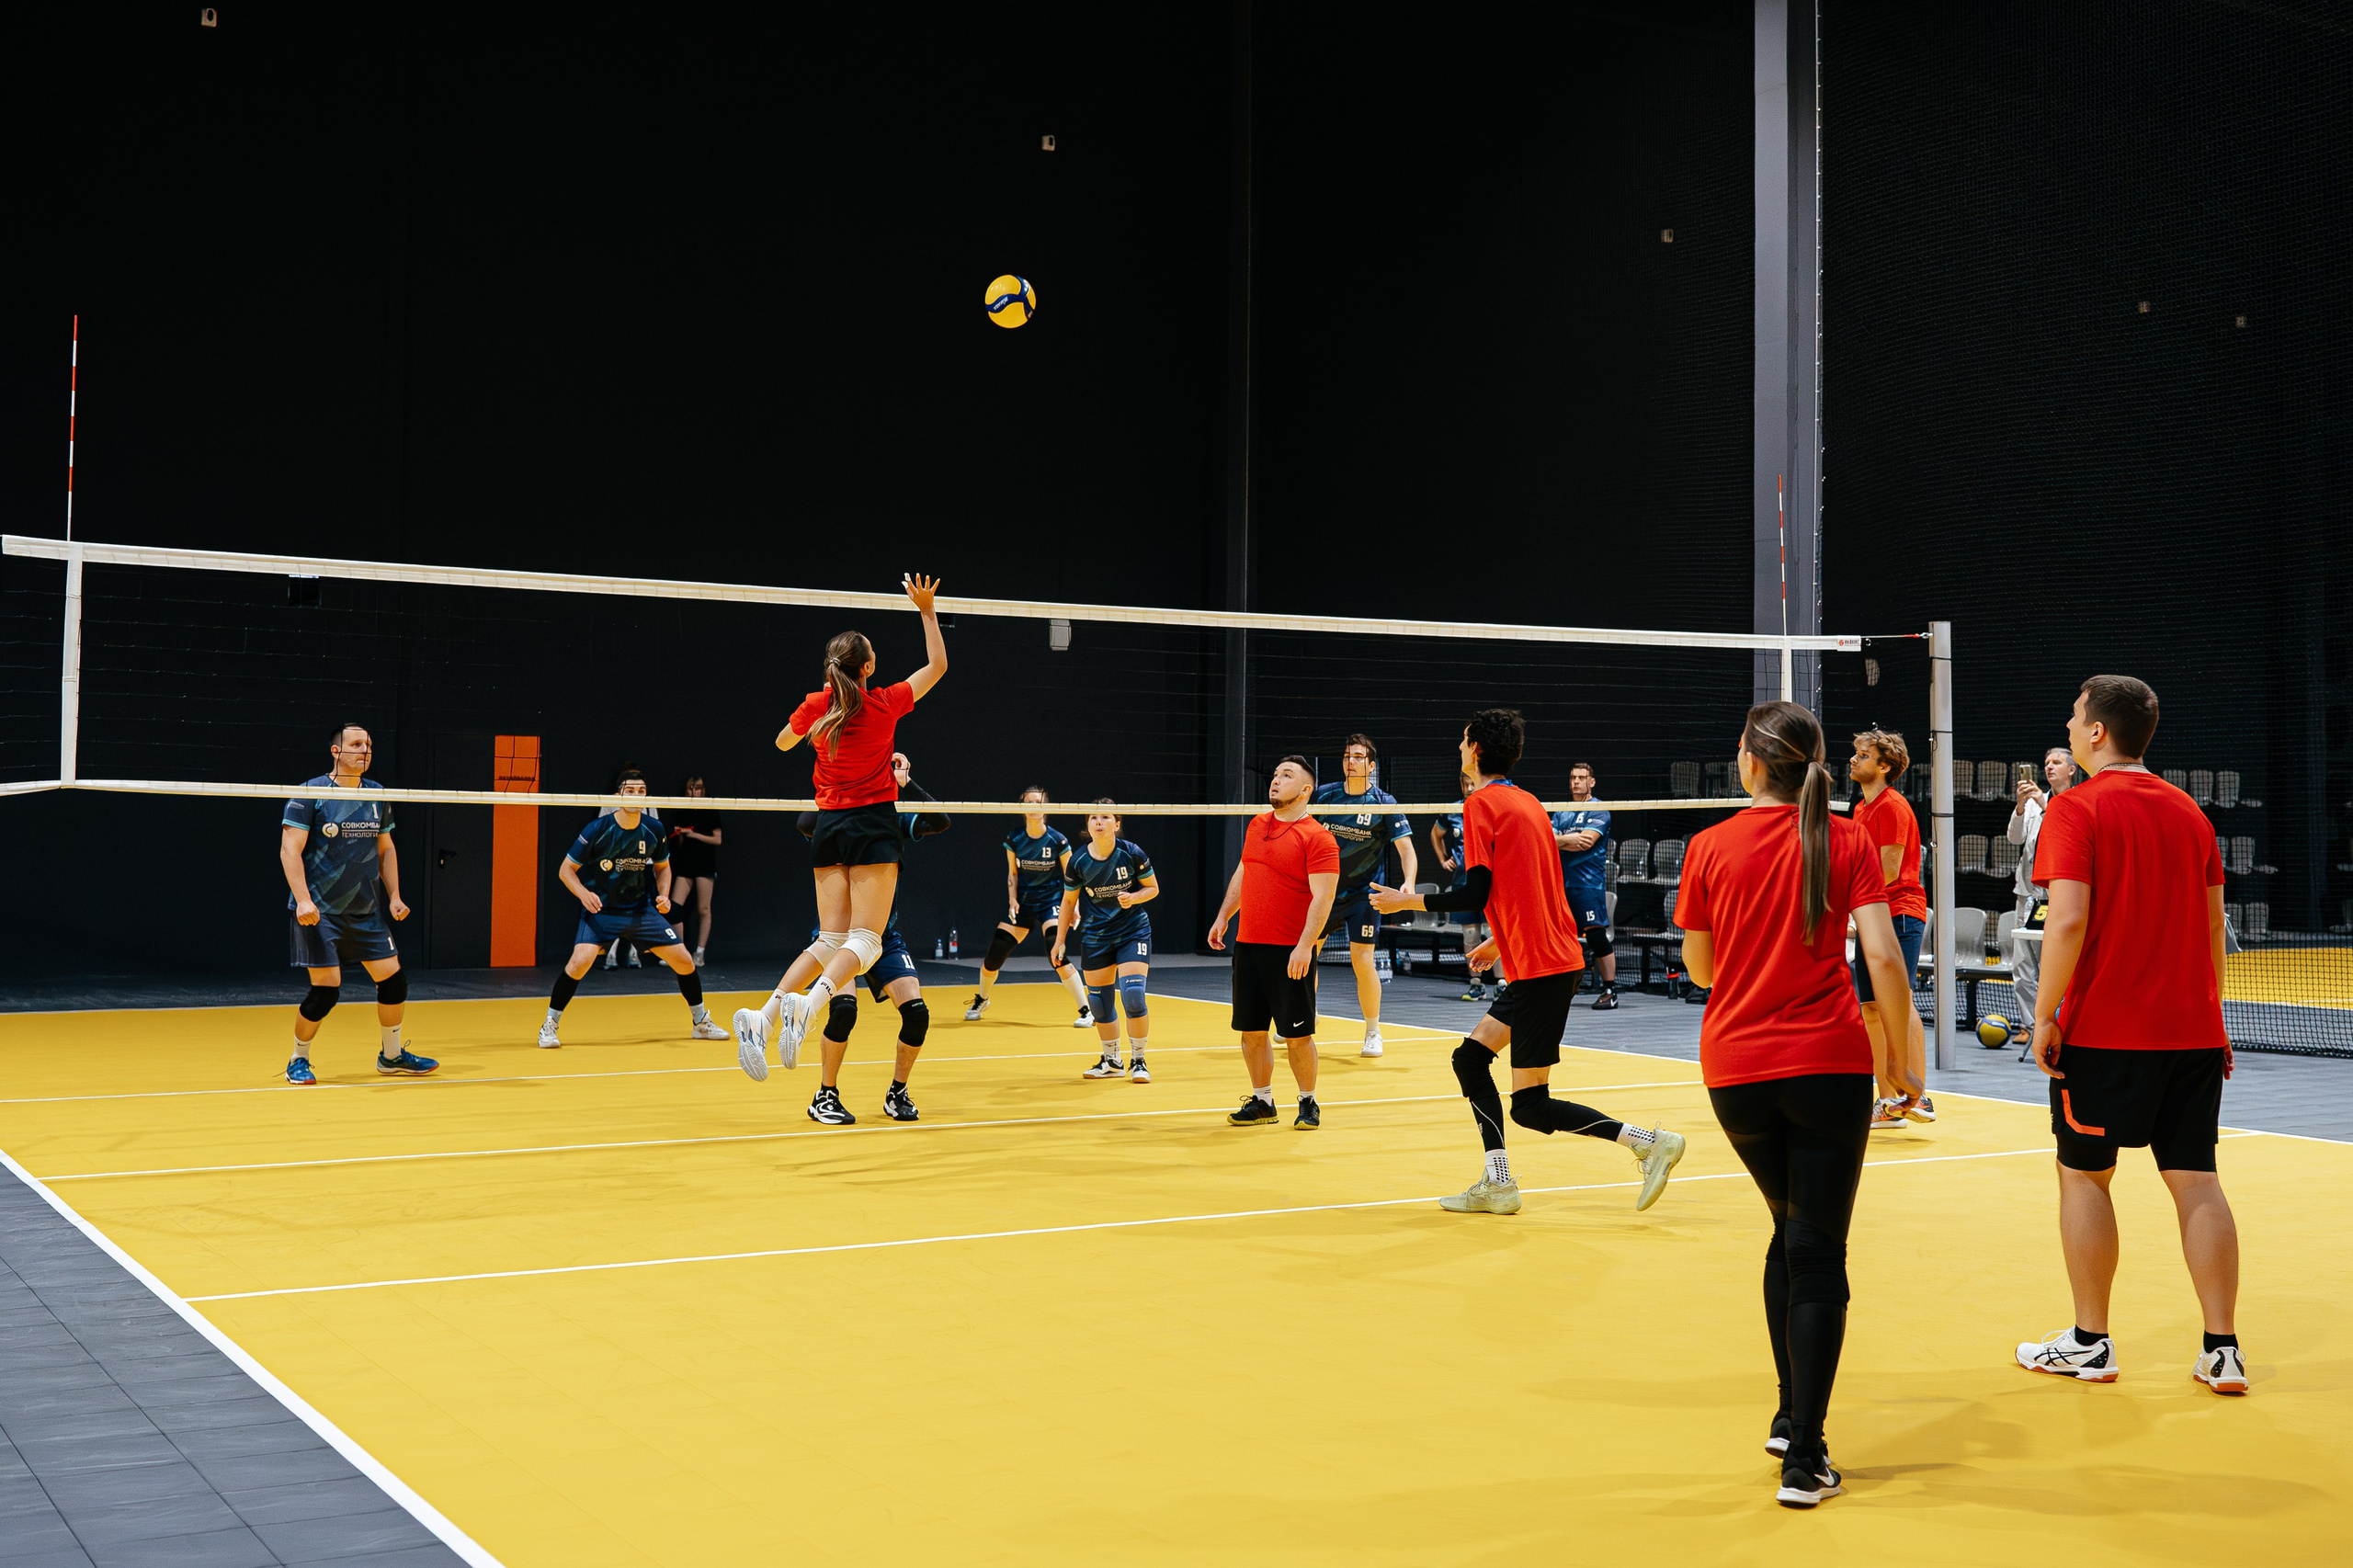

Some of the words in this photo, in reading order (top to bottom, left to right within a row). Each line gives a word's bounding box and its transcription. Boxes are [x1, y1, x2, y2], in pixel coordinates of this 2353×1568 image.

[371, 802, 379, 819] 1
[1356, 813, 1372, 826] 69
[638, 840, 646, 855] 9
[1041, 846, 1051, 858] 13
[1115, 866, 1129, 881] 19
[1586, 910, 1596, 922] 15
[665, 927, 677, 940] 9
[1361, 925, 1374, 937] 69
[387, 937, 395, 951] 1
[1137, 942, 1148, 956] 19
[901, 954, 915, 970] 11
[820, 981, 834, 998] FIL
